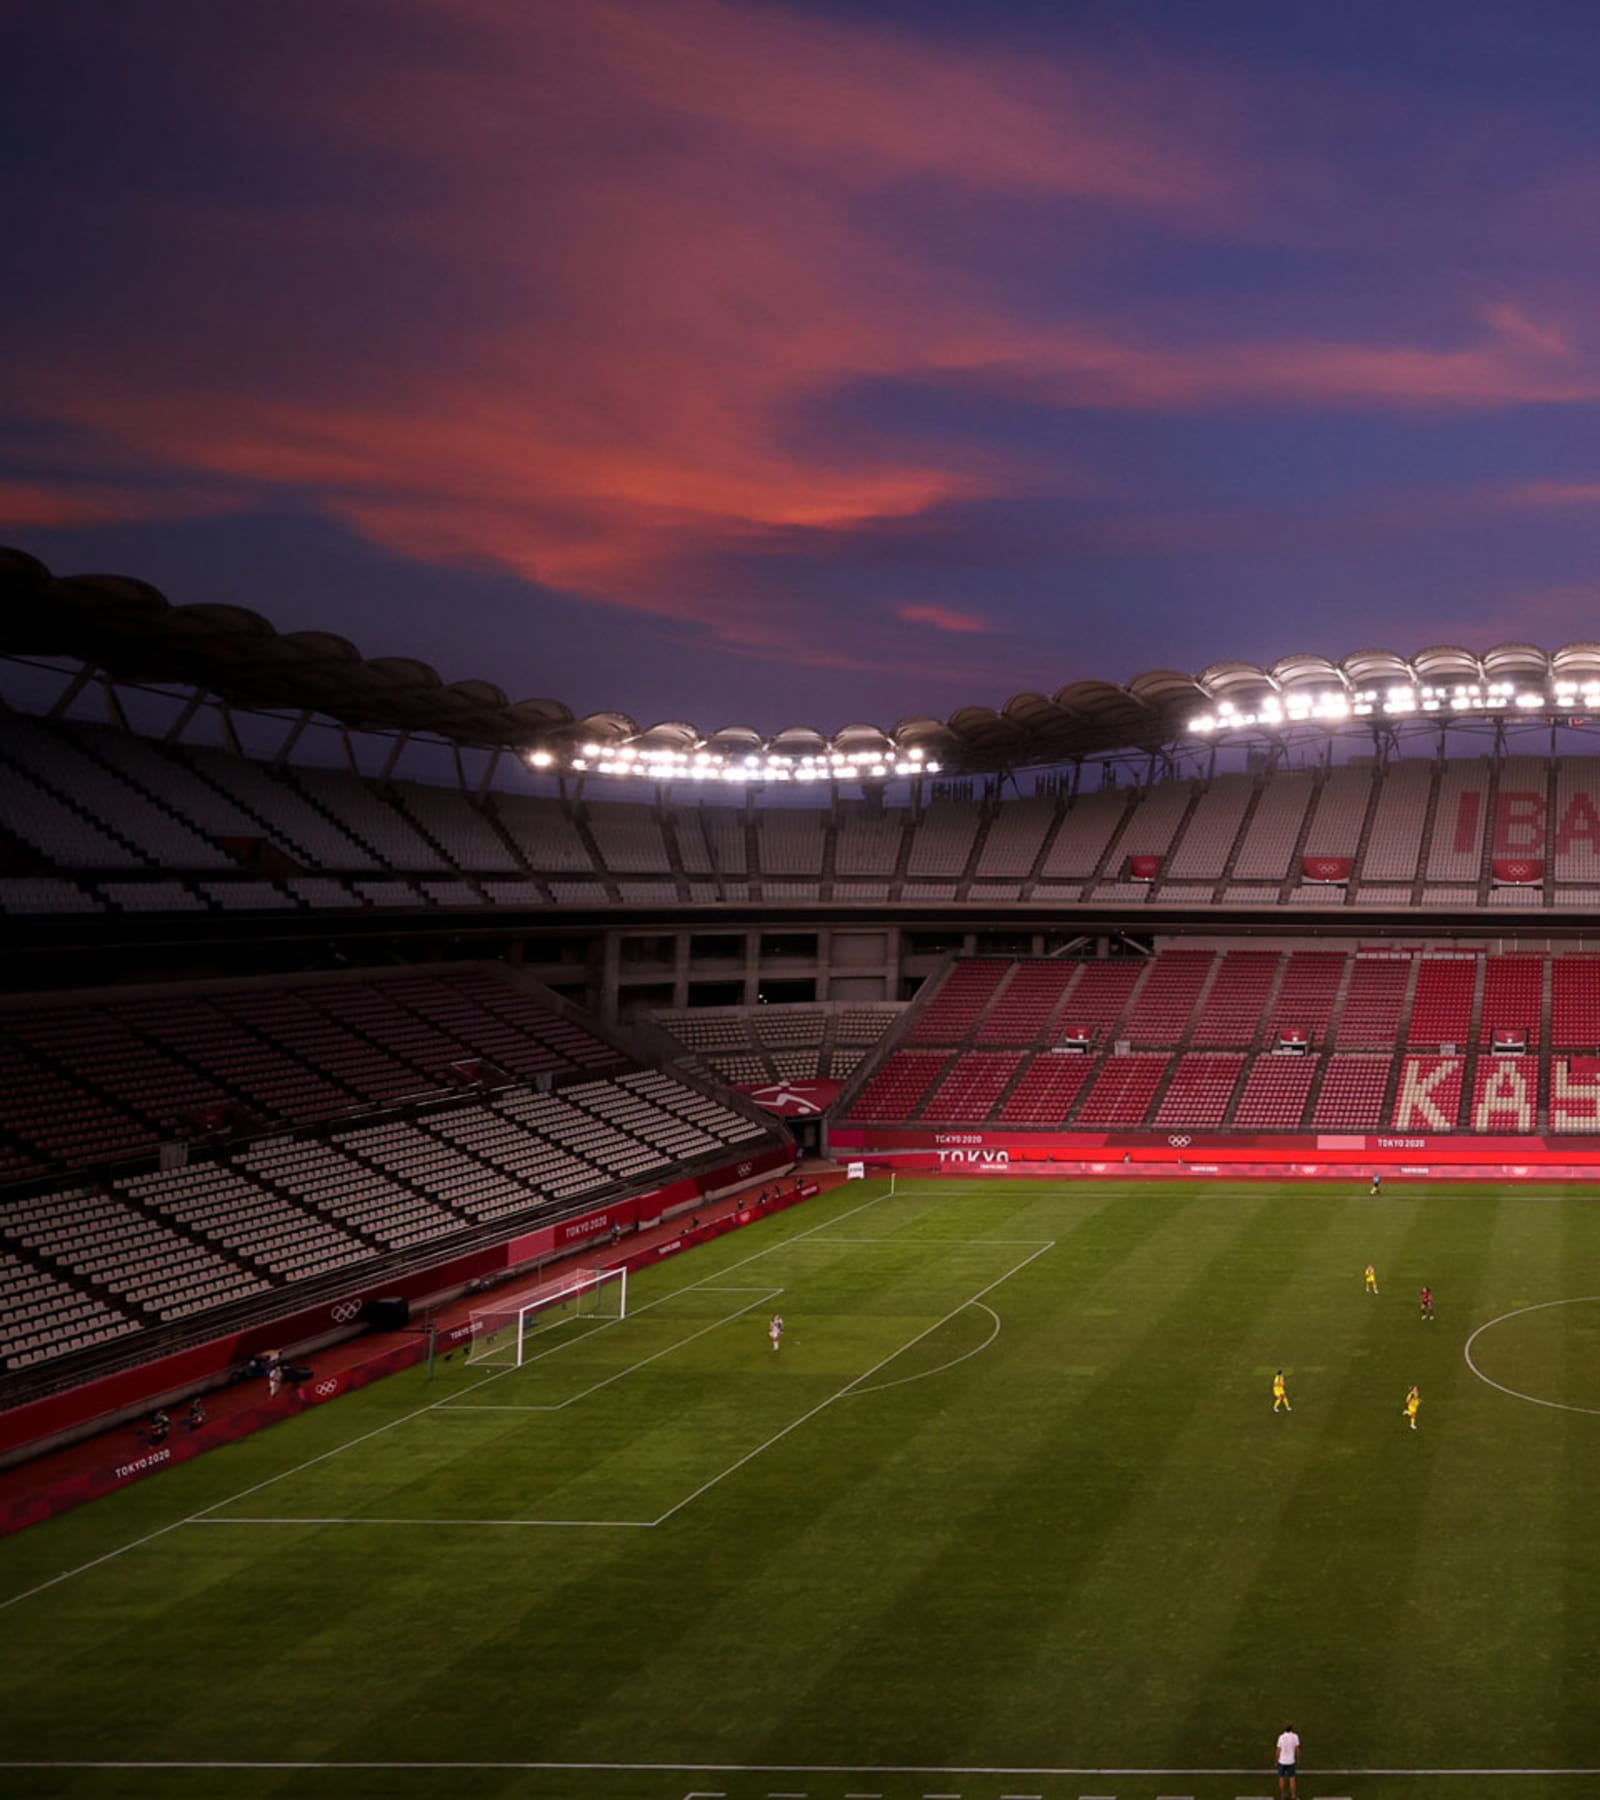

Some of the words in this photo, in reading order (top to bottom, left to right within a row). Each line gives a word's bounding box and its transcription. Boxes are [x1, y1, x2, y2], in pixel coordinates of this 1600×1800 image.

[935, 1134, 961, 1144] TOKYO
[1378, 1138, 1404, 1148] TOKYO
[1405, 1139, 1425, 1148] 2020
[565, 1221, 589, 1238] TOKYO
[590, 1215, 608, 1231] 2020
[115, 1458, 147, 1479] TOKYO
[147, 1448, 171, 1466] 2020
